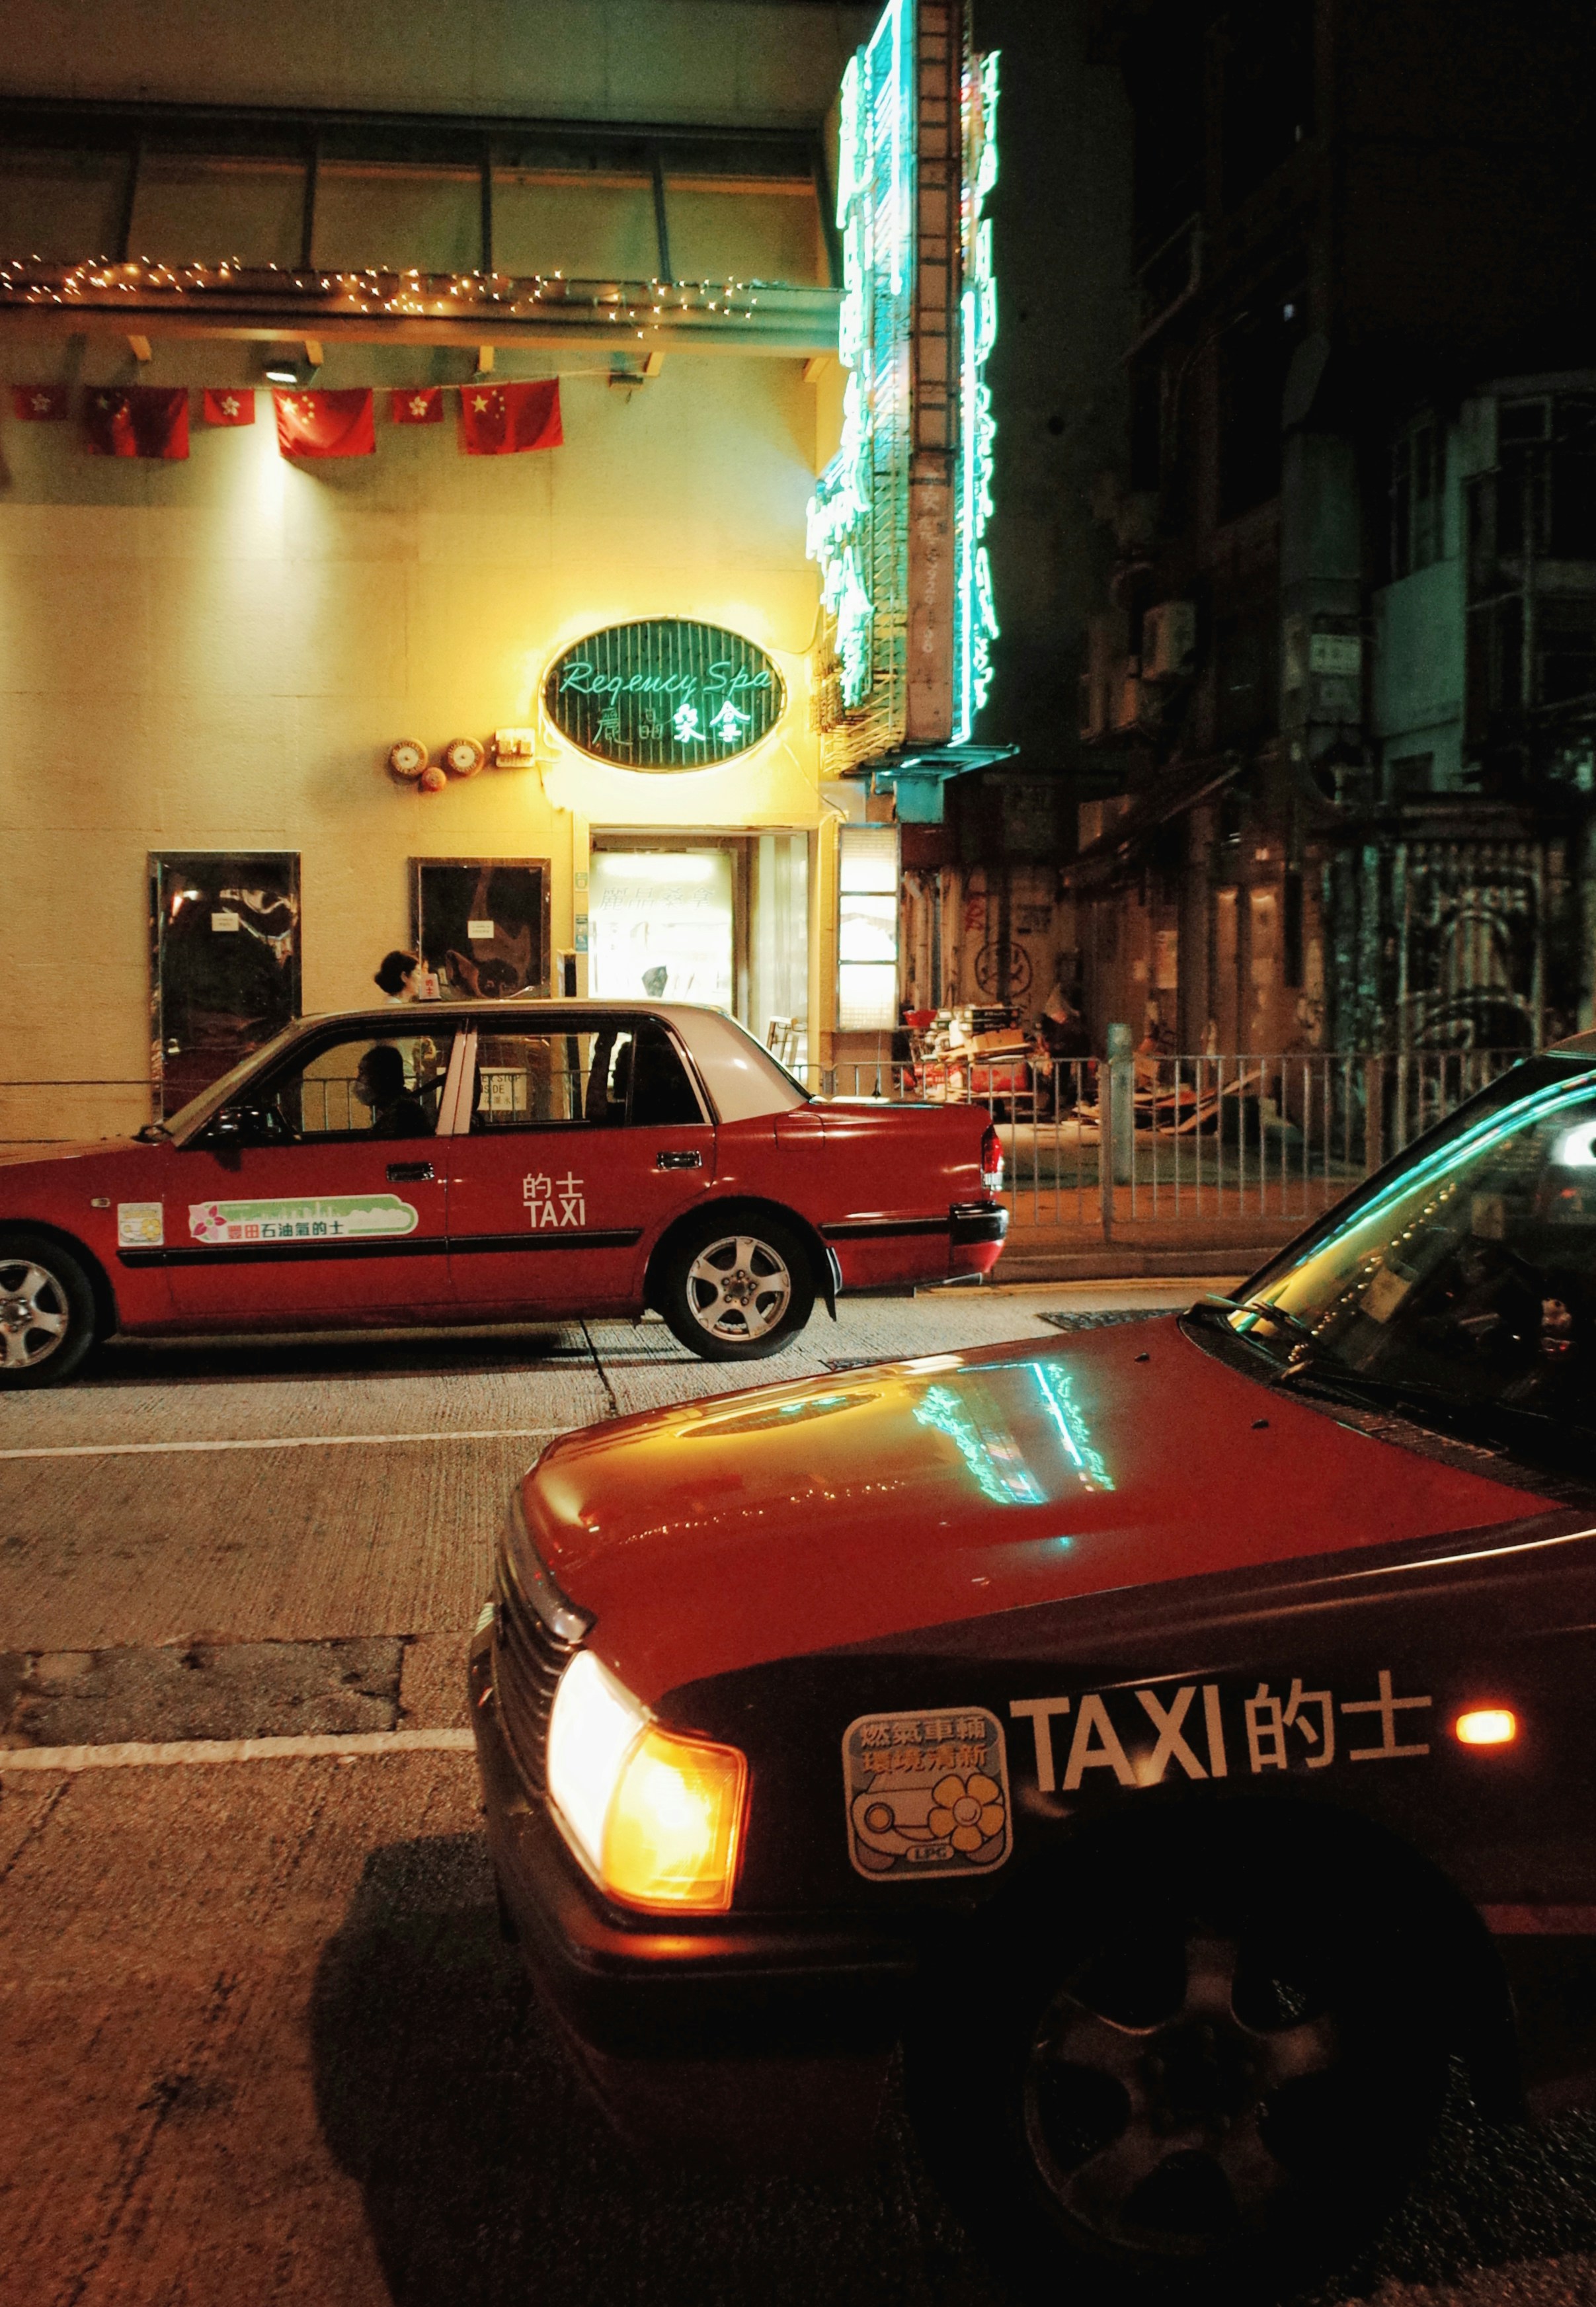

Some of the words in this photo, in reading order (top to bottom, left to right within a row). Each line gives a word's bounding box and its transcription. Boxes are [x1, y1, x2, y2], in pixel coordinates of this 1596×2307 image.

[559, 661, 698, 706] Regency
[703, 661, 772, 697] Spa
[523, 1171, 584, 1199] 的士
[523, 1199, 586, 1228] TAXI
[227, 1221, 344, 1239] 豐田石油氣的士
[861, 1717, 986, 1747] 燃氣車輛
[1244, 1670, 1432, 1773] 的士
[1009, 1683, 1228, 1793] TAXI
[862, 1742, 988, 1775] 環境清新
[915, 1845, 947, 1861] LPG
